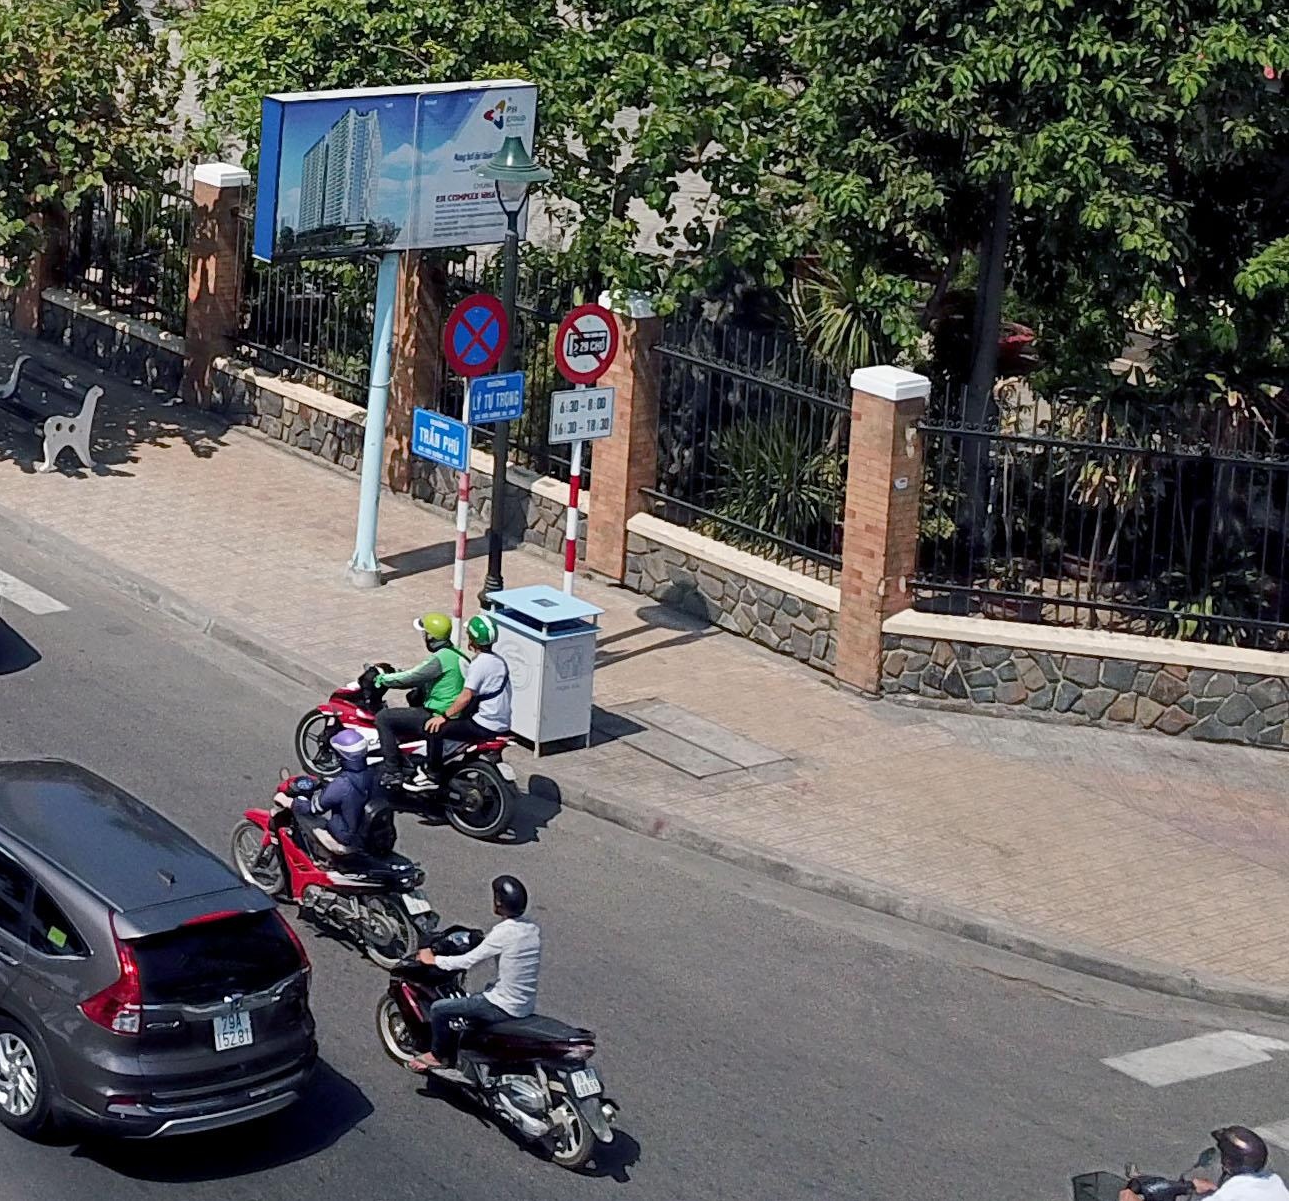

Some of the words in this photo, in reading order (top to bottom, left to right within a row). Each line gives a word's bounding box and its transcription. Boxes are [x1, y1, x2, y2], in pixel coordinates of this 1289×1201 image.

[560, 399, 578, 413] 6:30
[588, 397, 606, 411] 8:00
[554, 422, 577, 435] 16:30
[587, 417, 609, 432] 18:30
[443, 436, 460, 456] PHÚ
[221, 1013, 242, 1031] 79A
